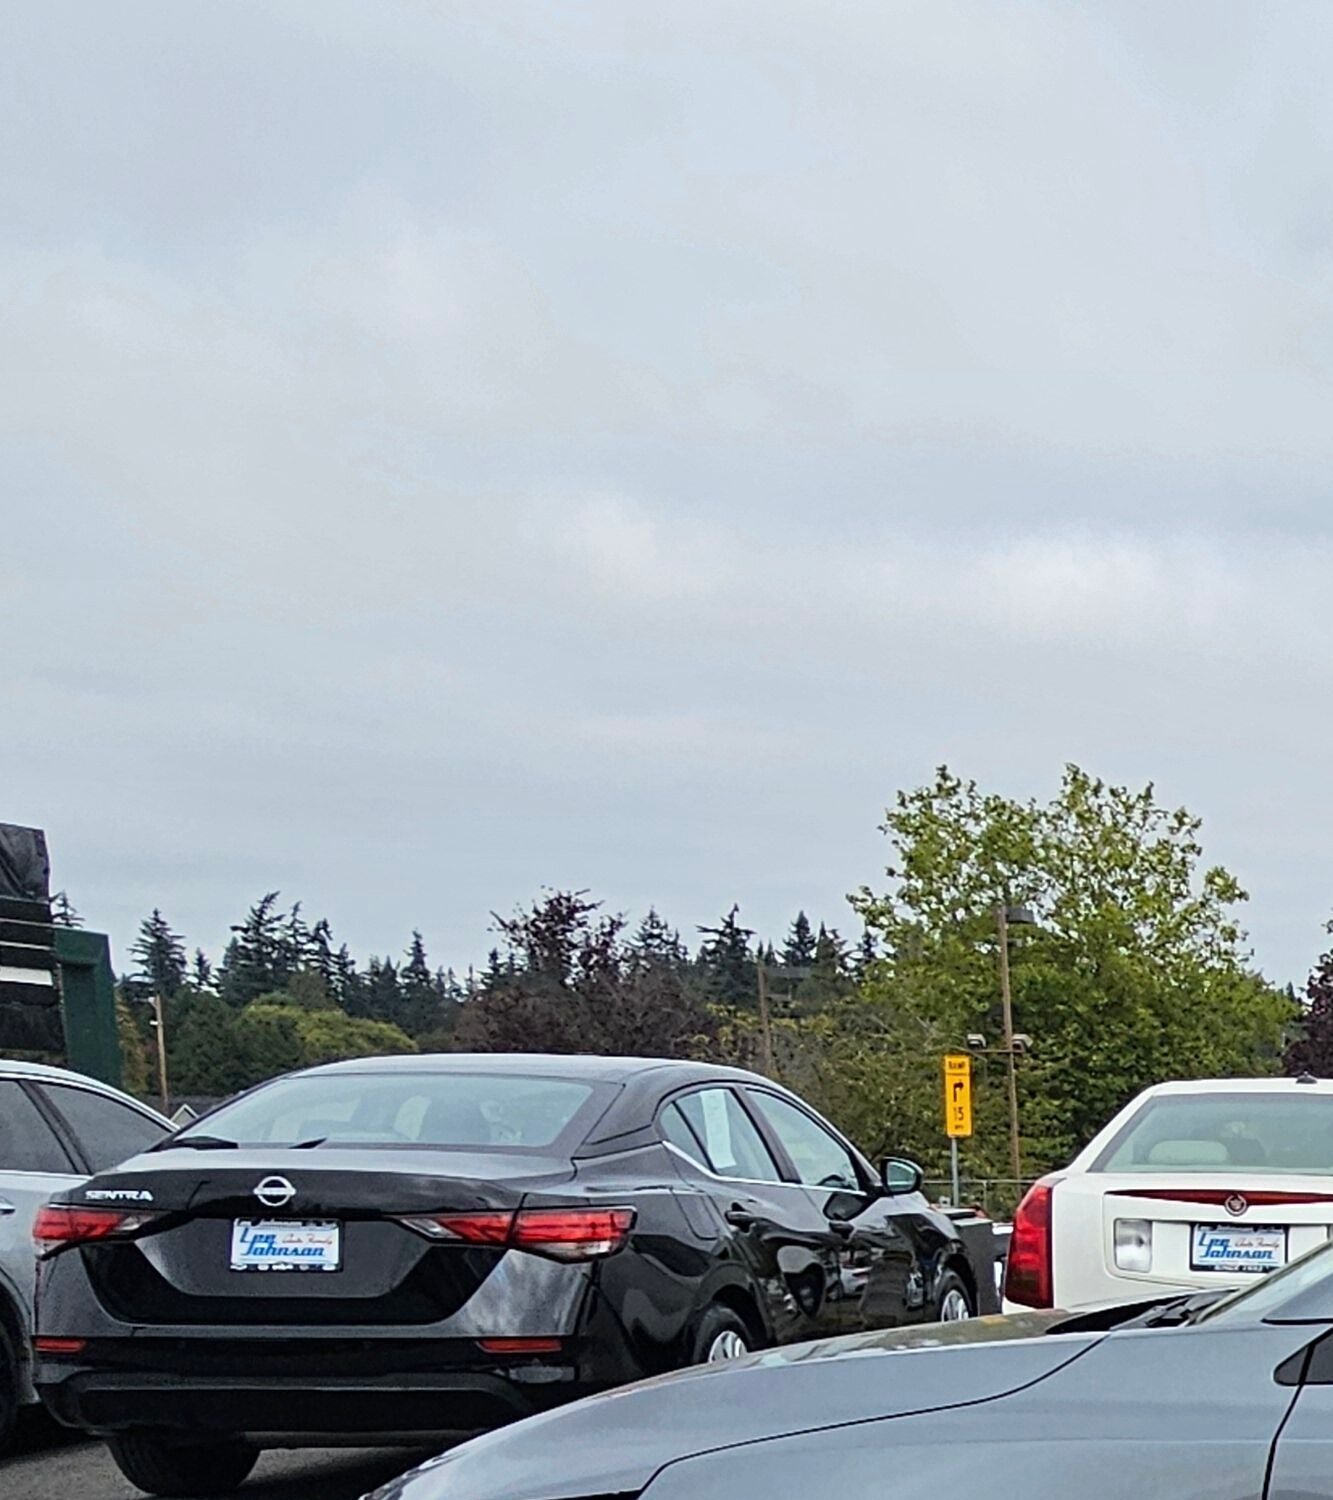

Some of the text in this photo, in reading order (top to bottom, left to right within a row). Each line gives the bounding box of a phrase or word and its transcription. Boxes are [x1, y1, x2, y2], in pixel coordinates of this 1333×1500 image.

[85, 1190, 153, 1201] SENTRA
[240, 1234, 324, 1256] Johnson
[1199, 1239, 1273, 1259] Johnson
